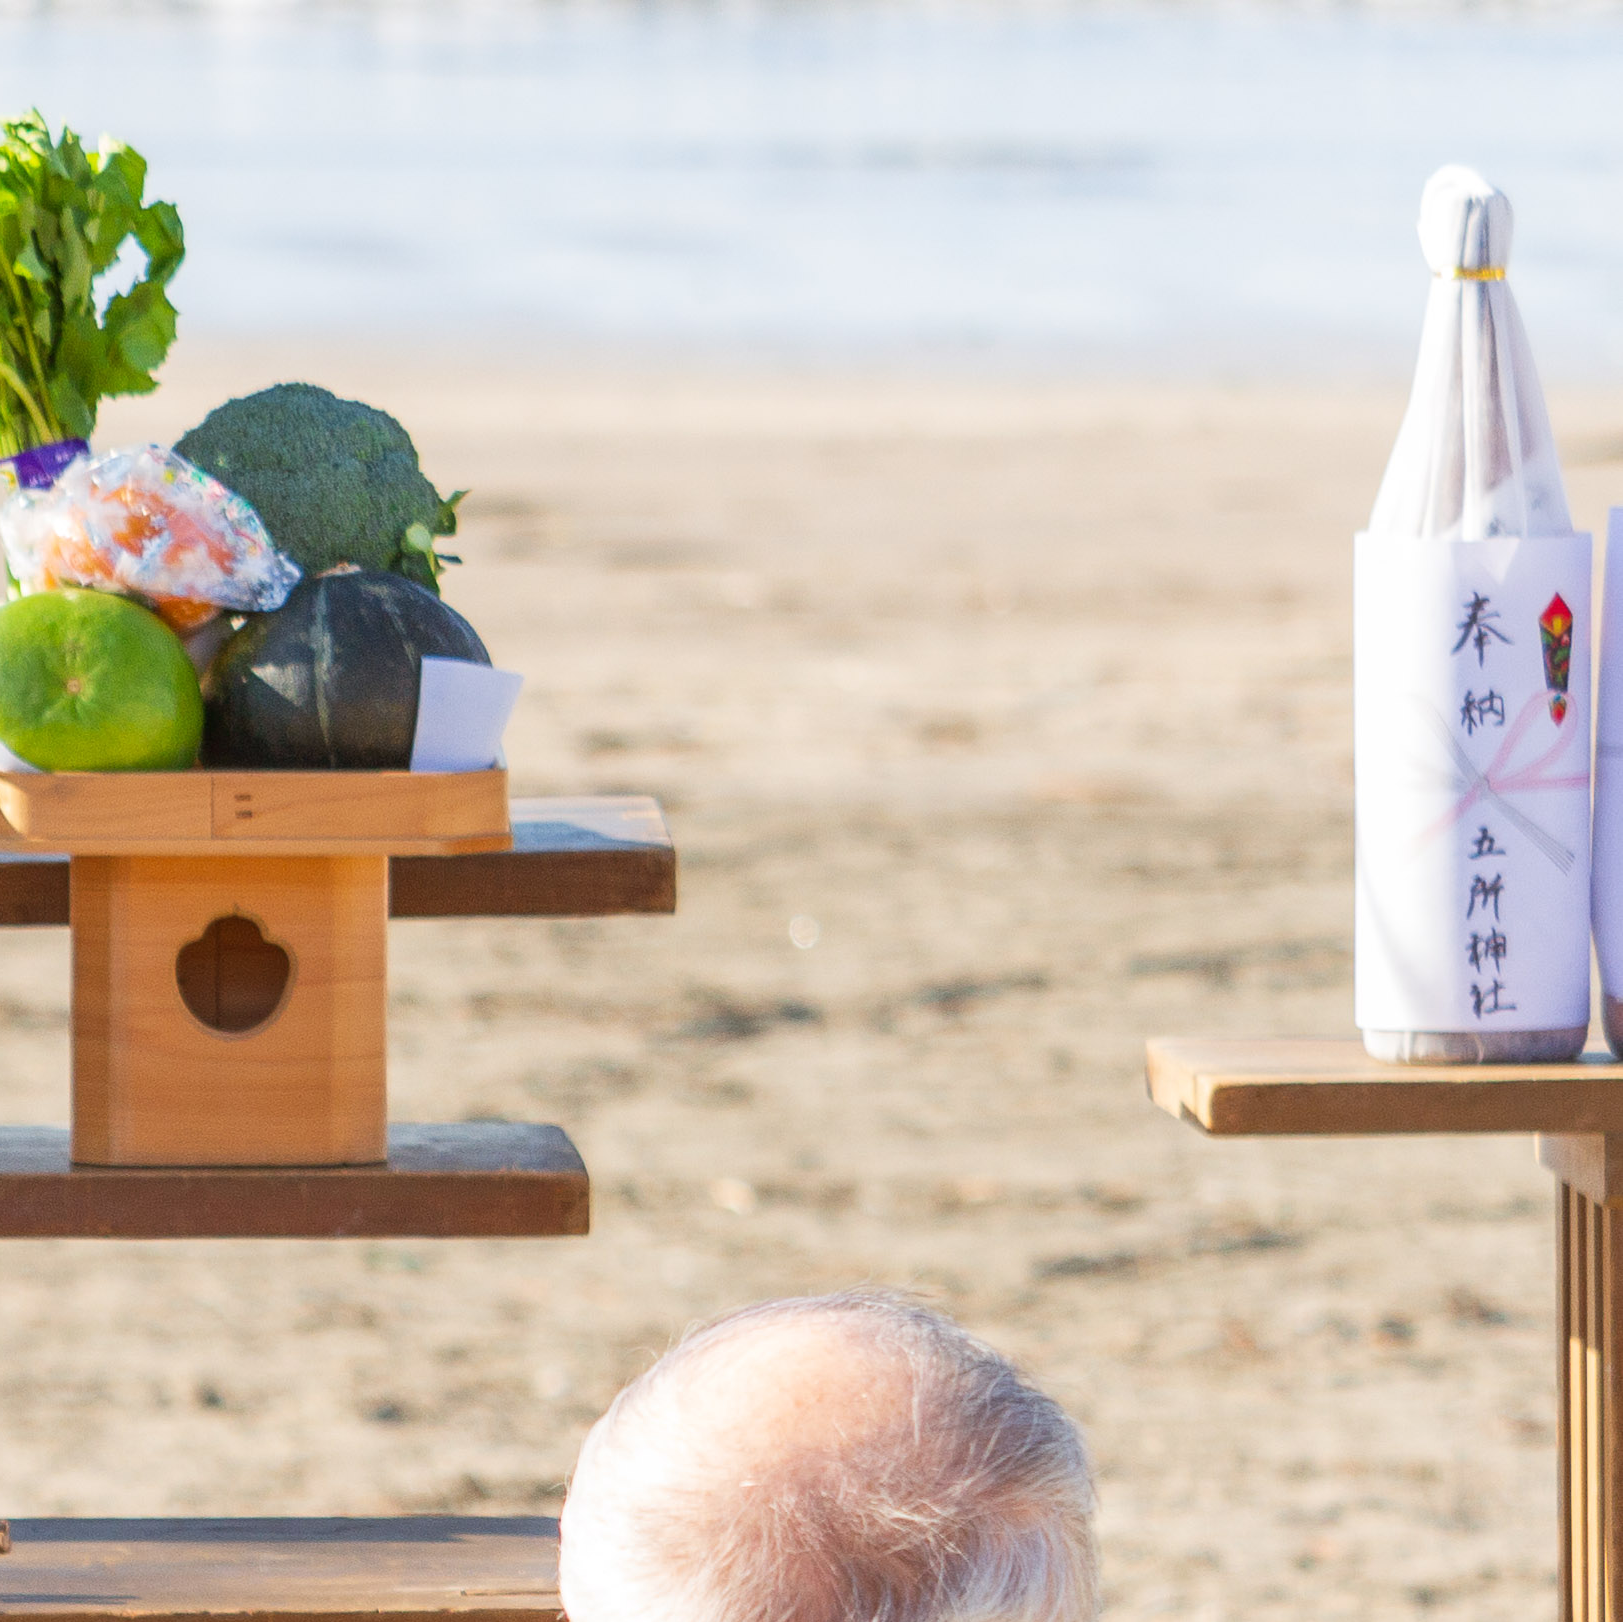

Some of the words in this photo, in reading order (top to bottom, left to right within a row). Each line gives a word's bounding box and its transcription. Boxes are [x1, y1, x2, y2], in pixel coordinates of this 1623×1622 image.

[1450, 590, 1515, 736] 奉納
[1465, 825, 1518, 1019] 五所神社
